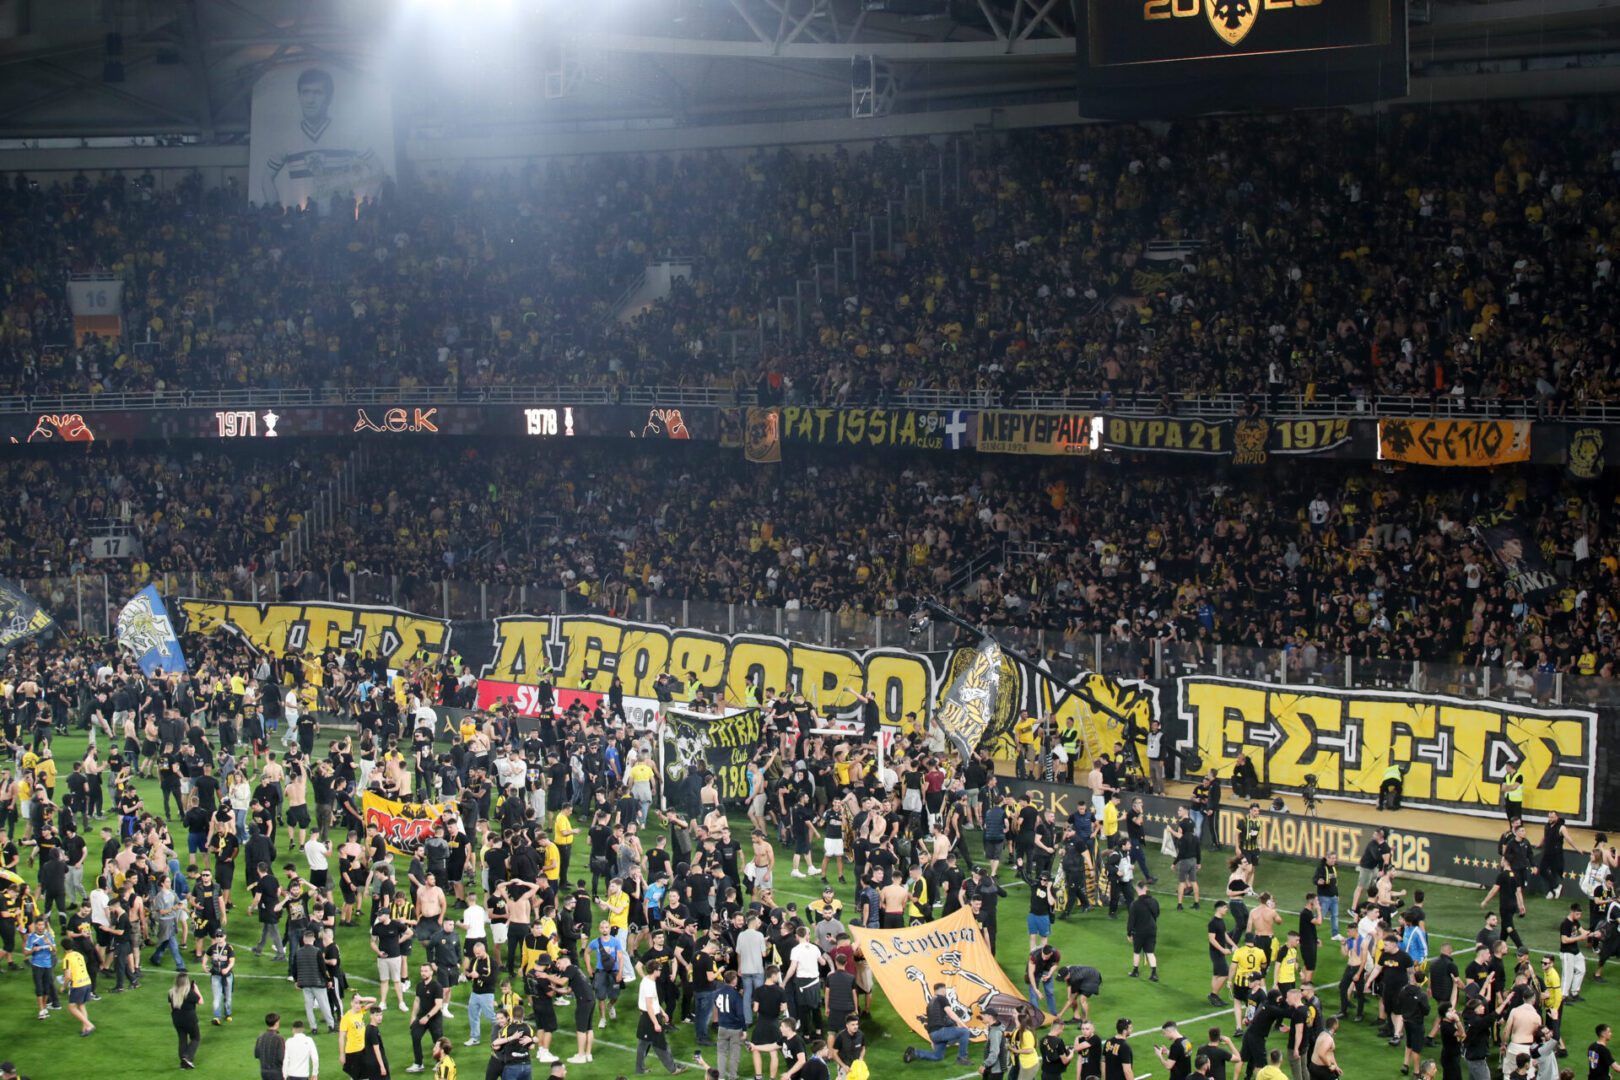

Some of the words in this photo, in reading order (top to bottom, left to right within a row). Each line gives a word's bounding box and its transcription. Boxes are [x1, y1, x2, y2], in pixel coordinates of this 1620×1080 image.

[86, 290, 107, 308] 16
[216, 411, 256, 437] 1971
[524, 409, 557, 435] 1978
[782, 407, 917, 447] PATISSIA
[1109, 418, 1183, 448] ΘΥΡΑ
[1188, 421, 1222, 451] 21
[917, 437, 943, 449] CLUB
[1232, 451, 1267, 465] ΛΑΥΡΙΟ
[104, 539, 120, 555] 17
[709, 710, 760, 747] PATRAS
[1188, 683, 1582, 815] ΕΣΕΙΣ
[1219, 810, 1363, 865] ΠΡΤΑΘΛΗΤΕΣ
[1388, 833, 1430, 873] 026
[1247, 954, 1256, 970] 9
